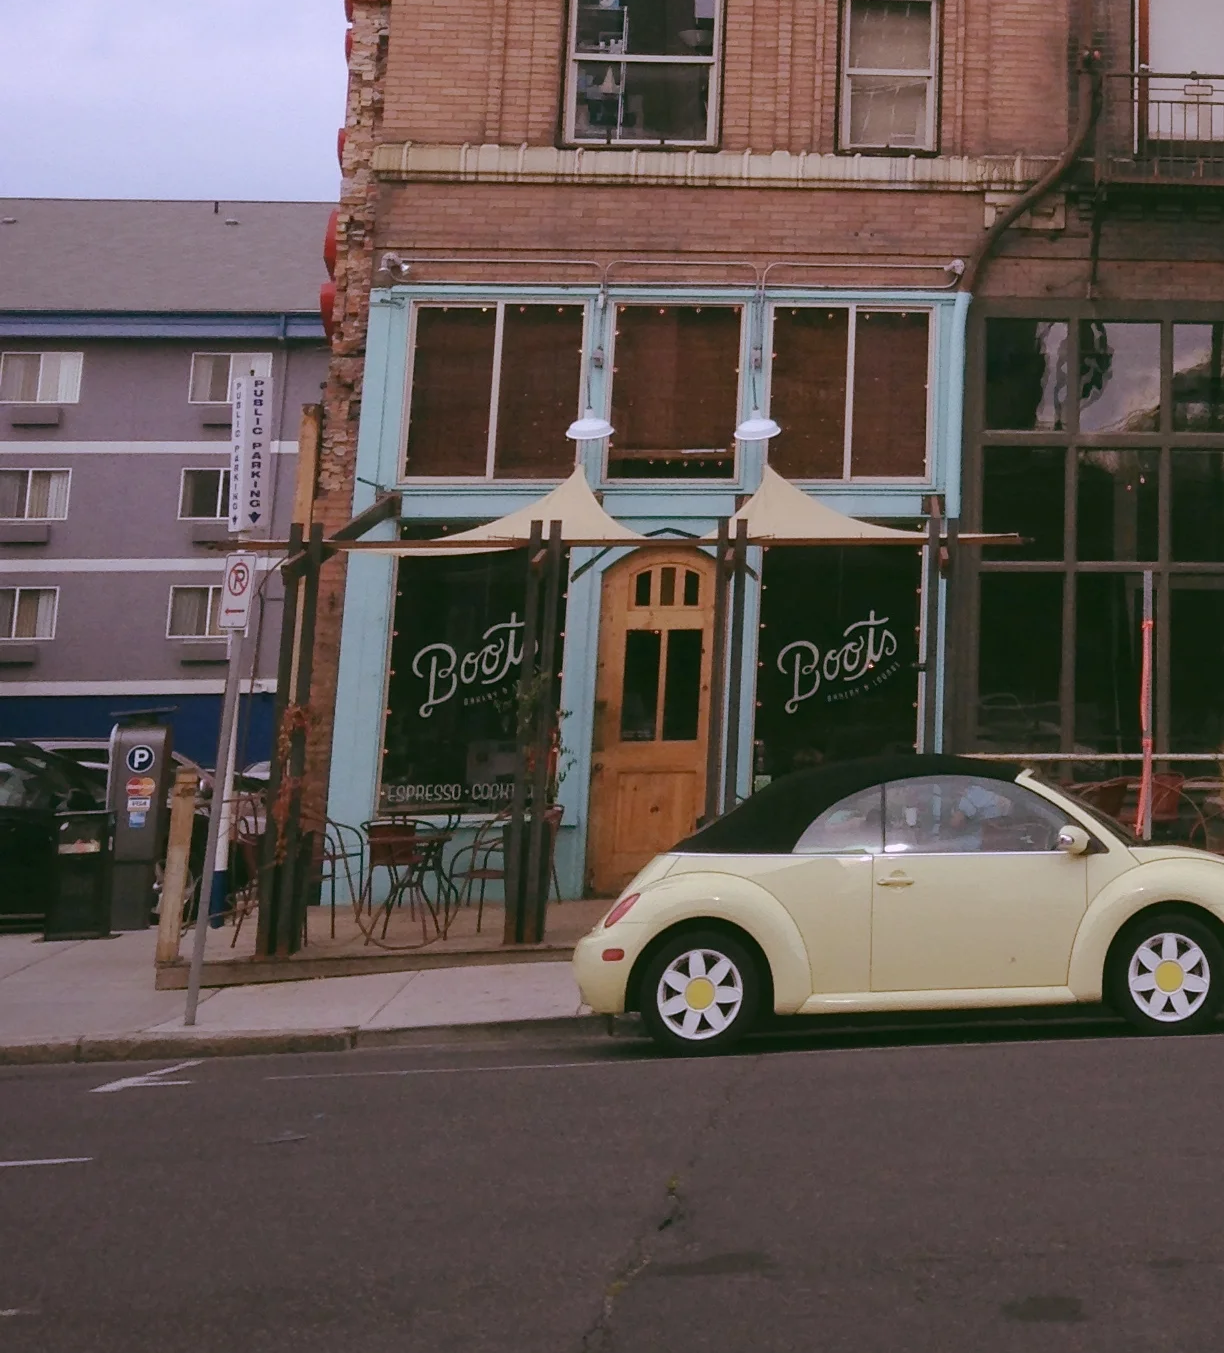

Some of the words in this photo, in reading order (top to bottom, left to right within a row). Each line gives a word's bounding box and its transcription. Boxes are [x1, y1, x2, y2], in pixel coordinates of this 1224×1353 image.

[235, 382, 243, 438] PUBLIC
[251, 379, 265, 436] PUBLIC
[232, 445, 240, 511] PARKING
[249, 442, 263, 509] PARKING
[777, 610, 897, 714] Boots
[387, 783, 462, 802] ESPRESSO
